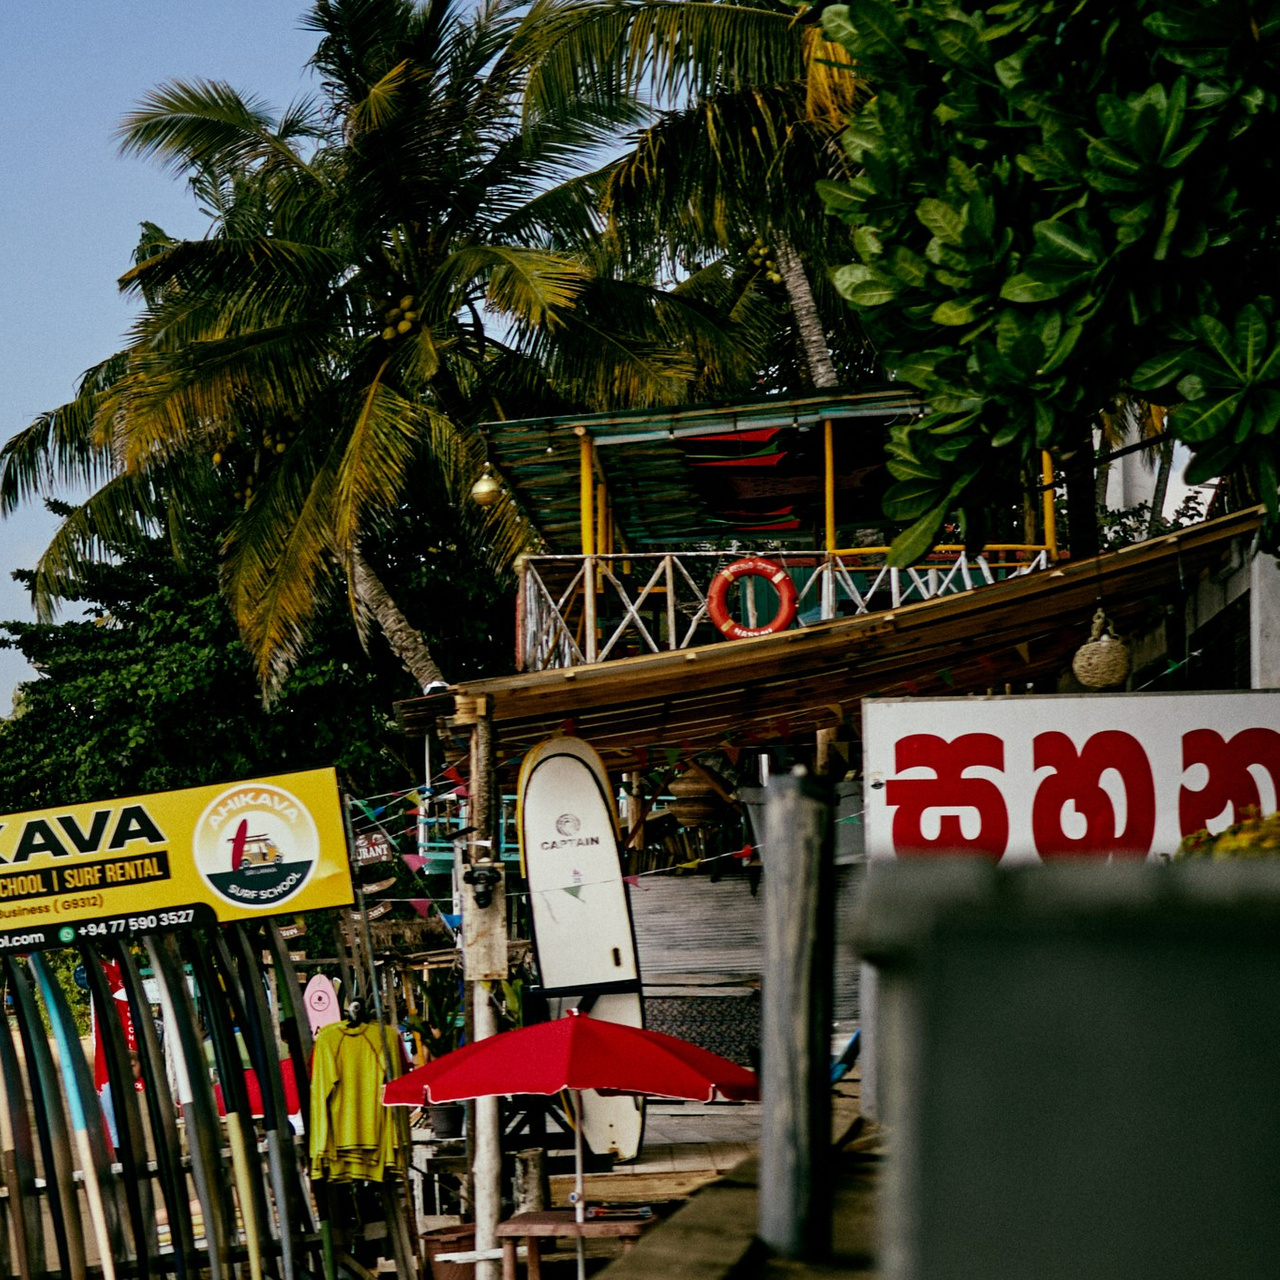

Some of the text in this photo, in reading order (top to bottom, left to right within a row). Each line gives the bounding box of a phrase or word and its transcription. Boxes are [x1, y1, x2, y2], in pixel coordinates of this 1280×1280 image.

[209, 792, 299, 831] AHIKAVA
[541, 836, 600, 850] CAPTAIN
[64, 865, 102, 888] SURF
[106, 857, 163, 883] RENTAL
[228, 872, 302, 899] SURF SCHOOL
[78, 909, 195, 938] +94 77 590 3527
